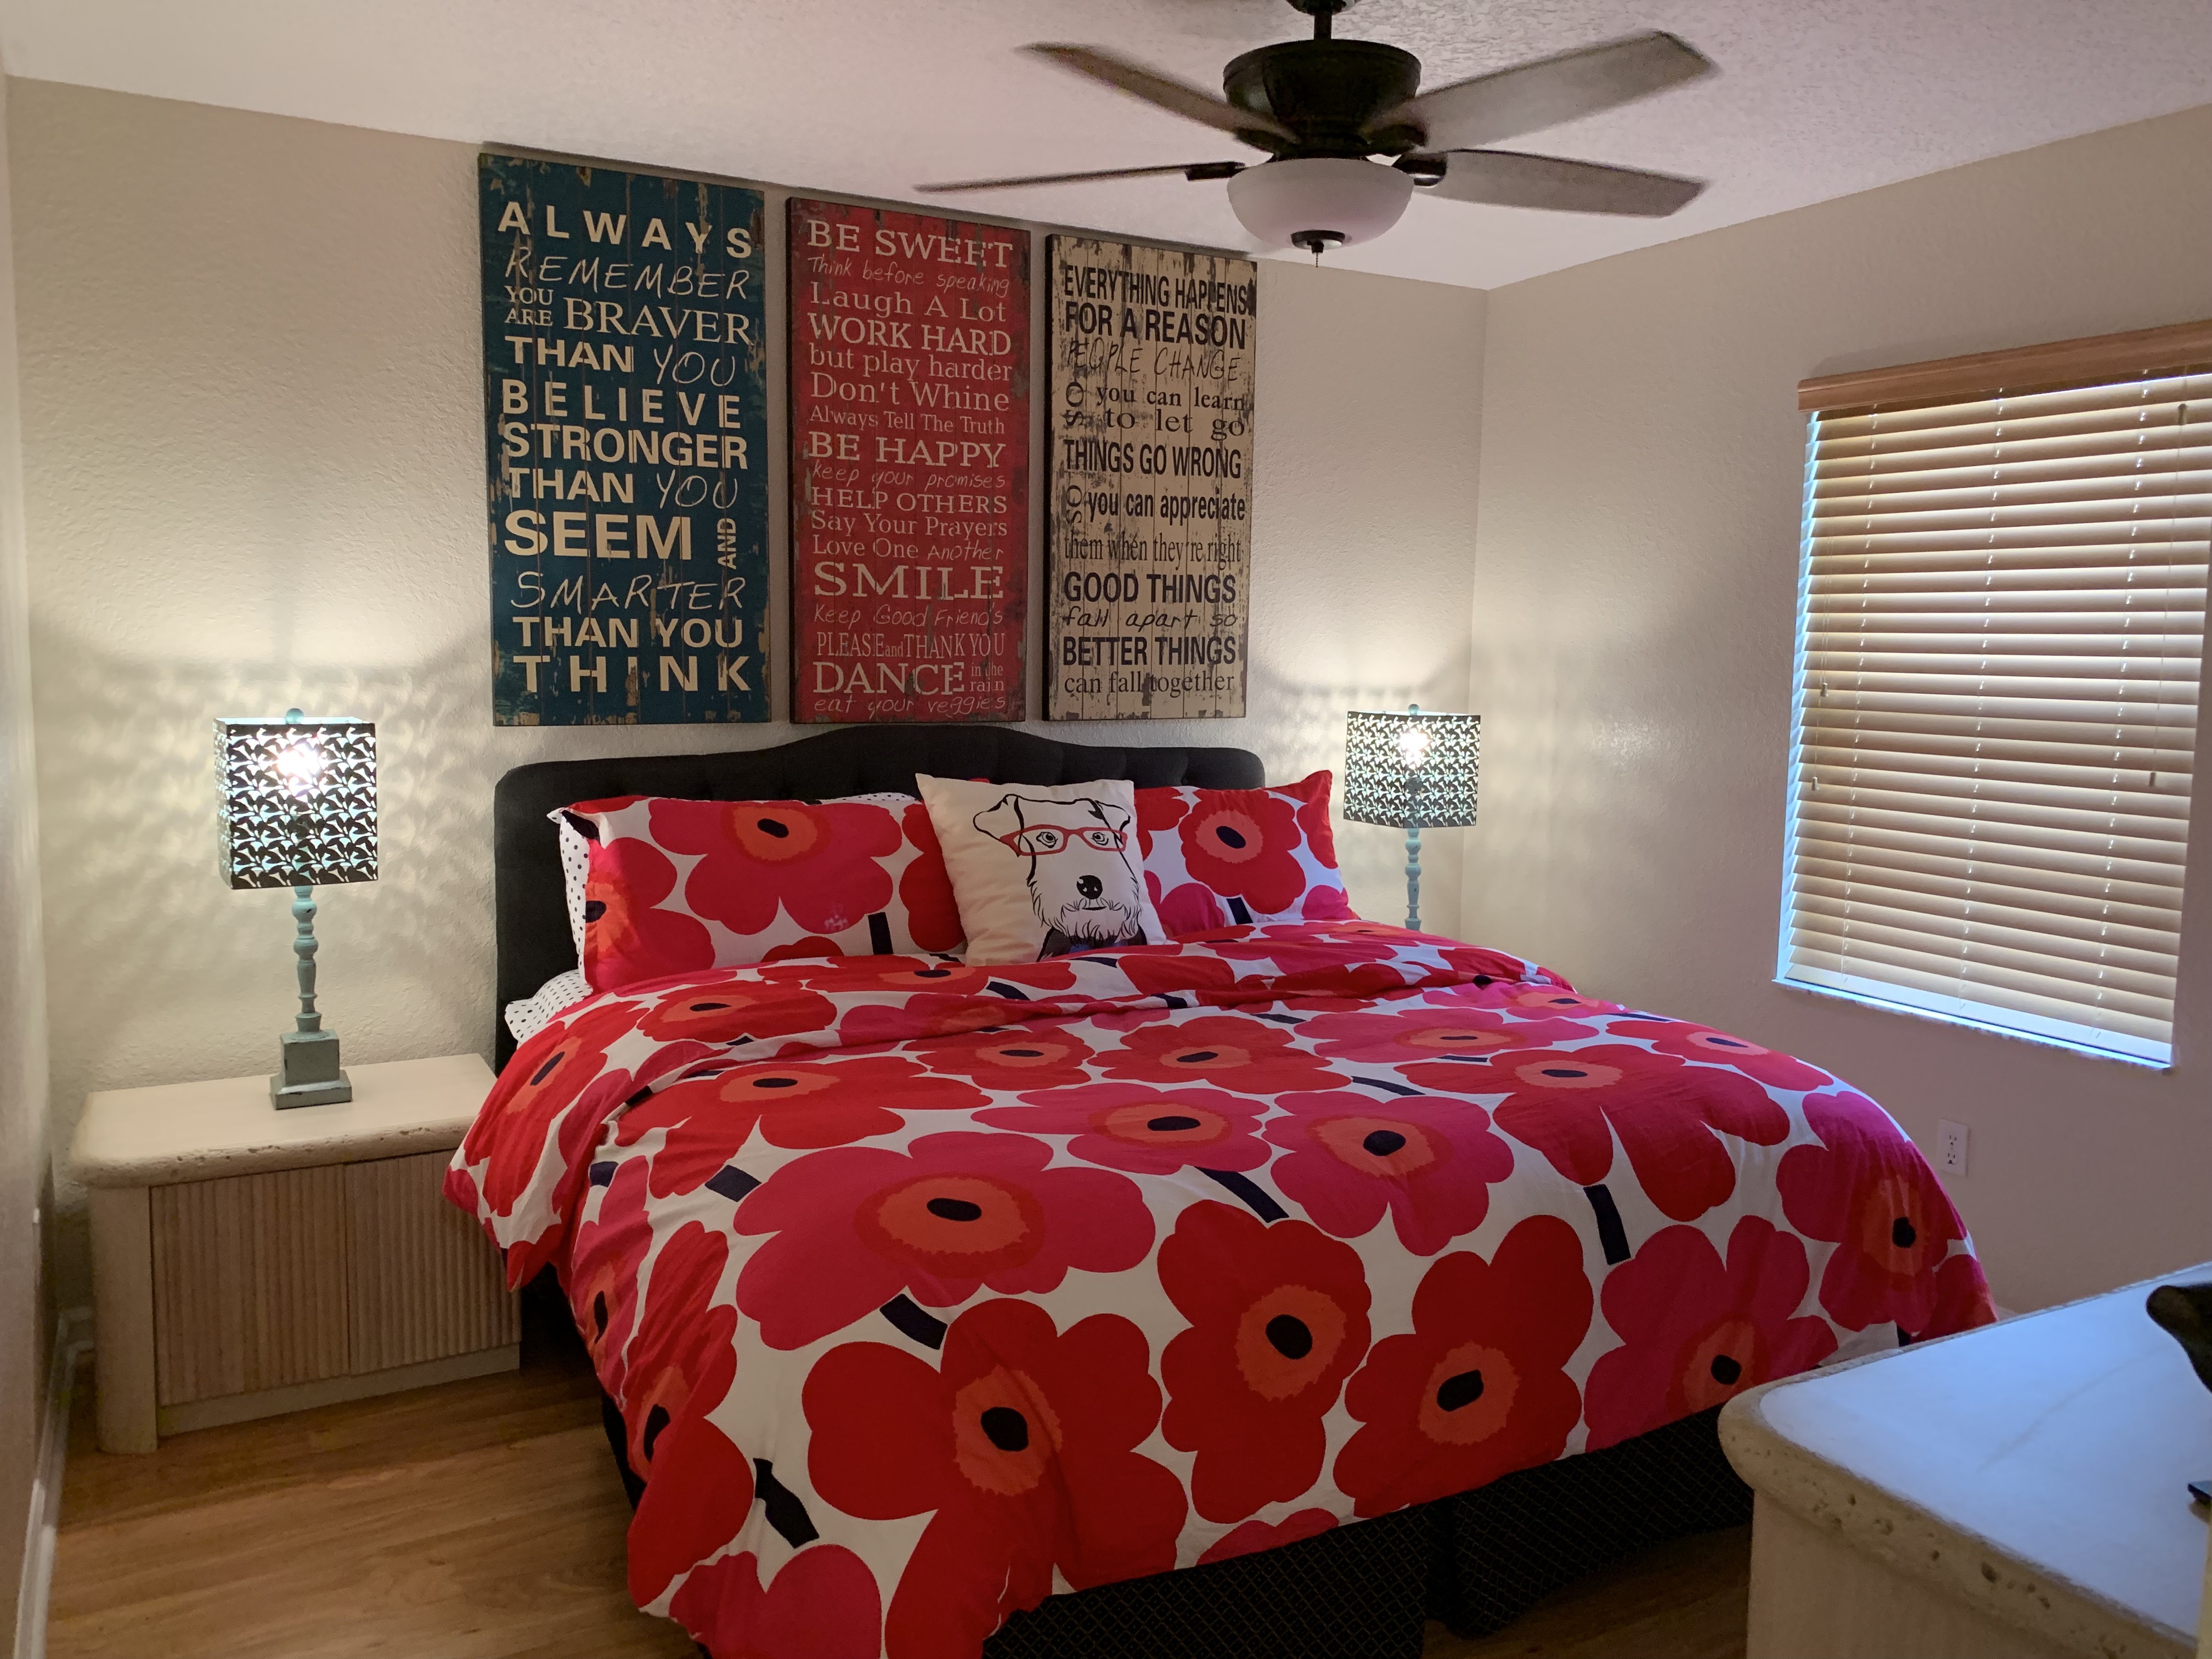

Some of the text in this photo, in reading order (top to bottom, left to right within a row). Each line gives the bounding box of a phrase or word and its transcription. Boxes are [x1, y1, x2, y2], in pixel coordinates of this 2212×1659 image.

[498, 201, 752, 258] ALWAYS
[808, 219, 1013, 267] BE SWEET
[505, 246, 749, 299] REMEMBER
[808, 253, 1009, 297] Think before speaking
[1064, 264, 1169, 306] EVERYTHING
[505, 286, 554, 304] YOU
[810, 281, 1006, 322] Laugh A Lot
[505, 309, 554, 326] ARE
[563, 297, 754, 345] BRAVER
[808, 313, 1011, 356] WORK HARD
[1065, 302, 1246, 349] FOR A REASON
[505, 336, 735, 386] THAN YOU
[809, 343, 1012, 381] but play harder
[1067, 337, 1240, 381] PEOPLE CHANGE
[502, 379, 741, 428] BELIEVE
[811, 372, 1009, 411] Don't Whine
[1097, 386, 1245, 410] you can learn
[810, 405, 1005, 434] Always Tell The Truth
[1105, 408, 1245, 441] to let go
[506, 422, 748, 469] STRONGER
[809, 431, 1006, 468] BE HAPPY
[1064, 439, 1241, 478] THINGS GO WRONG
[510, 467, 737, 509] THAN YOU
[812, 459, 1005, 492] keep your promises
[811, 487, 1007, 514] HELP OTHERS
[1088, 492, 1245, 526] you can appreciate
[504, 510, 691, 560] SEEM
[717, 518, 736, 569] AND
[812, 510, 1007, 540] Say Your Prayers
[812, 534, 1003, 561] Love One Another
[1065, 532, 1241, 571] them when they're right
[511, 571, 746, 614] SMARTER
[815, 561, 1003, 601] SMILE
[1064, 572, 1236, 603] GOOD THINGS
[512, 617, 742, 647] THAN YOU
[815, 604, 861, 630] Keep
[873, 604, 928, 627] Good
[1062, 606, 1237, 633] fall apart so
[817, 632, 1005, 658] PLEASE and THANK YOU
[1063, 636, 1236, 665] BETTER THINGS
[513, 655, 751, 693] THINK
[813, 662, 964, 695] DANCE
[969, 678, 1005, 692] rain
[971, 662, 1003, 676] in the
[1064, 670, 1234, 698] can fall together
[815, 695, 1006, 719] eat your veggies
